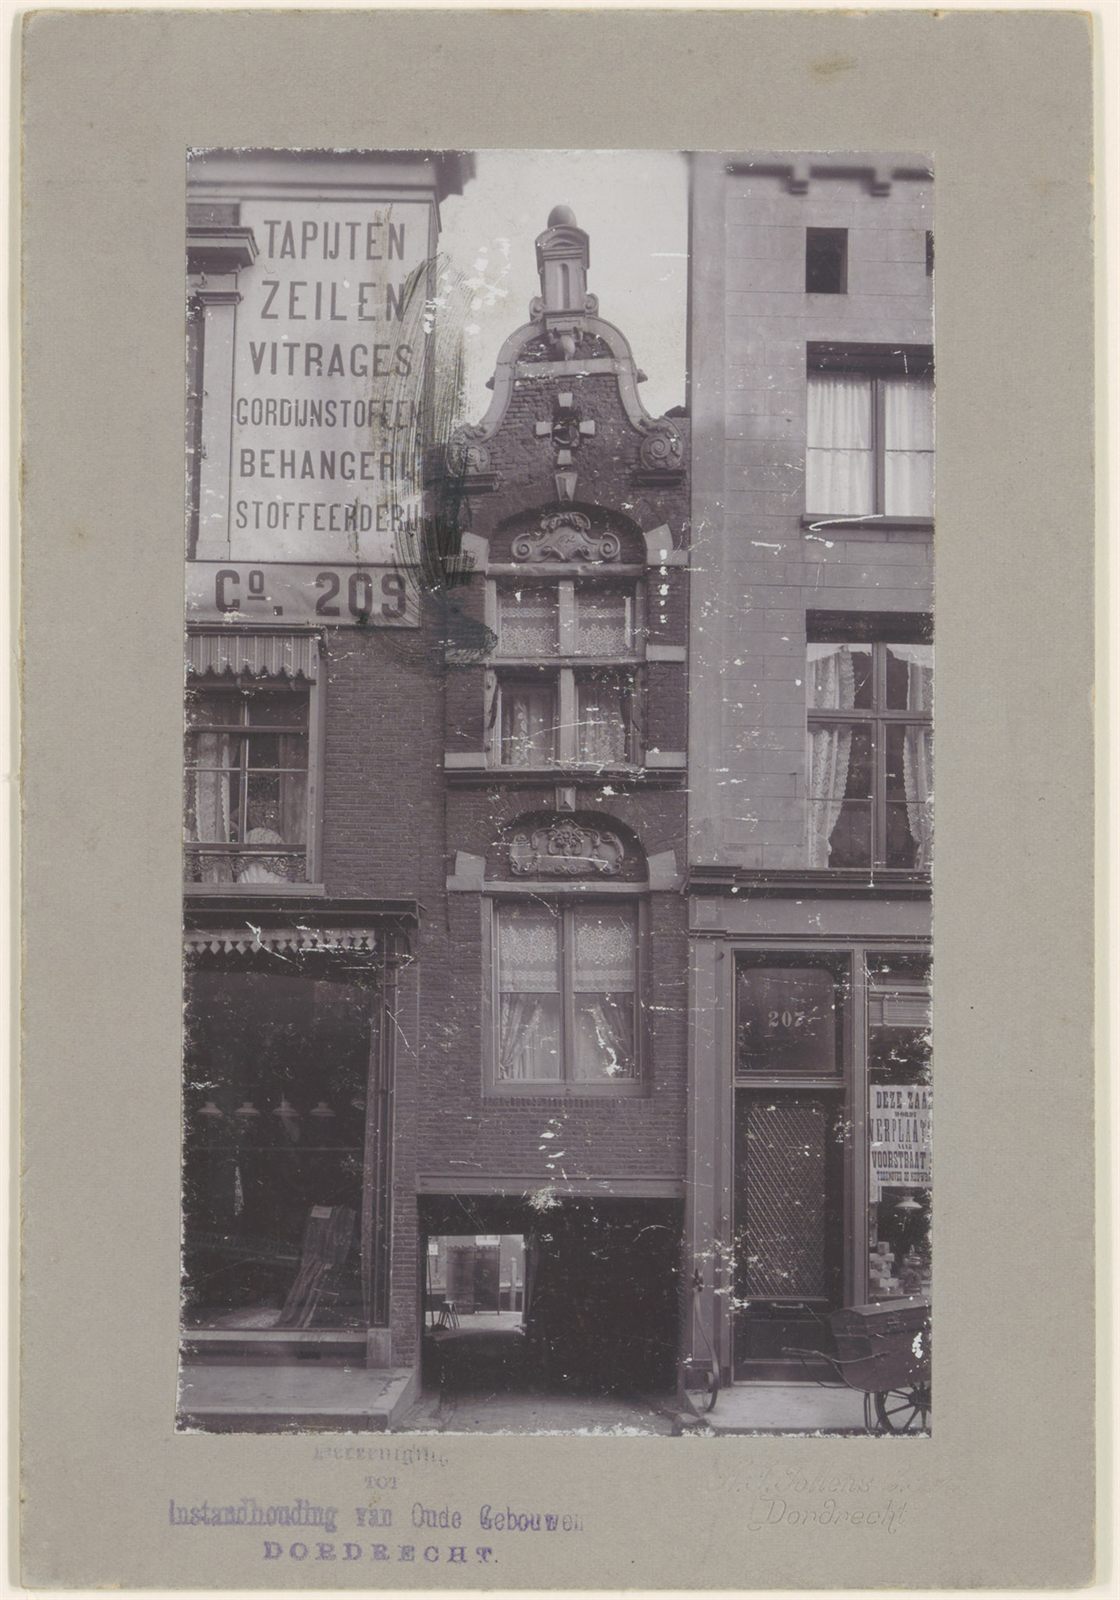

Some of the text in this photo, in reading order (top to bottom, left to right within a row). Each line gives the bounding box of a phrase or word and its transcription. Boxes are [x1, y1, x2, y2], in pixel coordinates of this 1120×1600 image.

[263, 220, 405, 261] TAPIJTEN
[260, 279, 405, 322] ZEILEN
[249, 341, 413, 378] VITRAGES
[236, 501, 418, 533] STOFFEERDERIJ
[315, 571, 407, 618] 209
[876, 1091, 903, 1109] DEZE
[871, 1151, 927, 1169] VOORSTRAAT
[169, 1498, 338, 1533] Instandhouding
[411, 1502, 462, 1530] Oude
